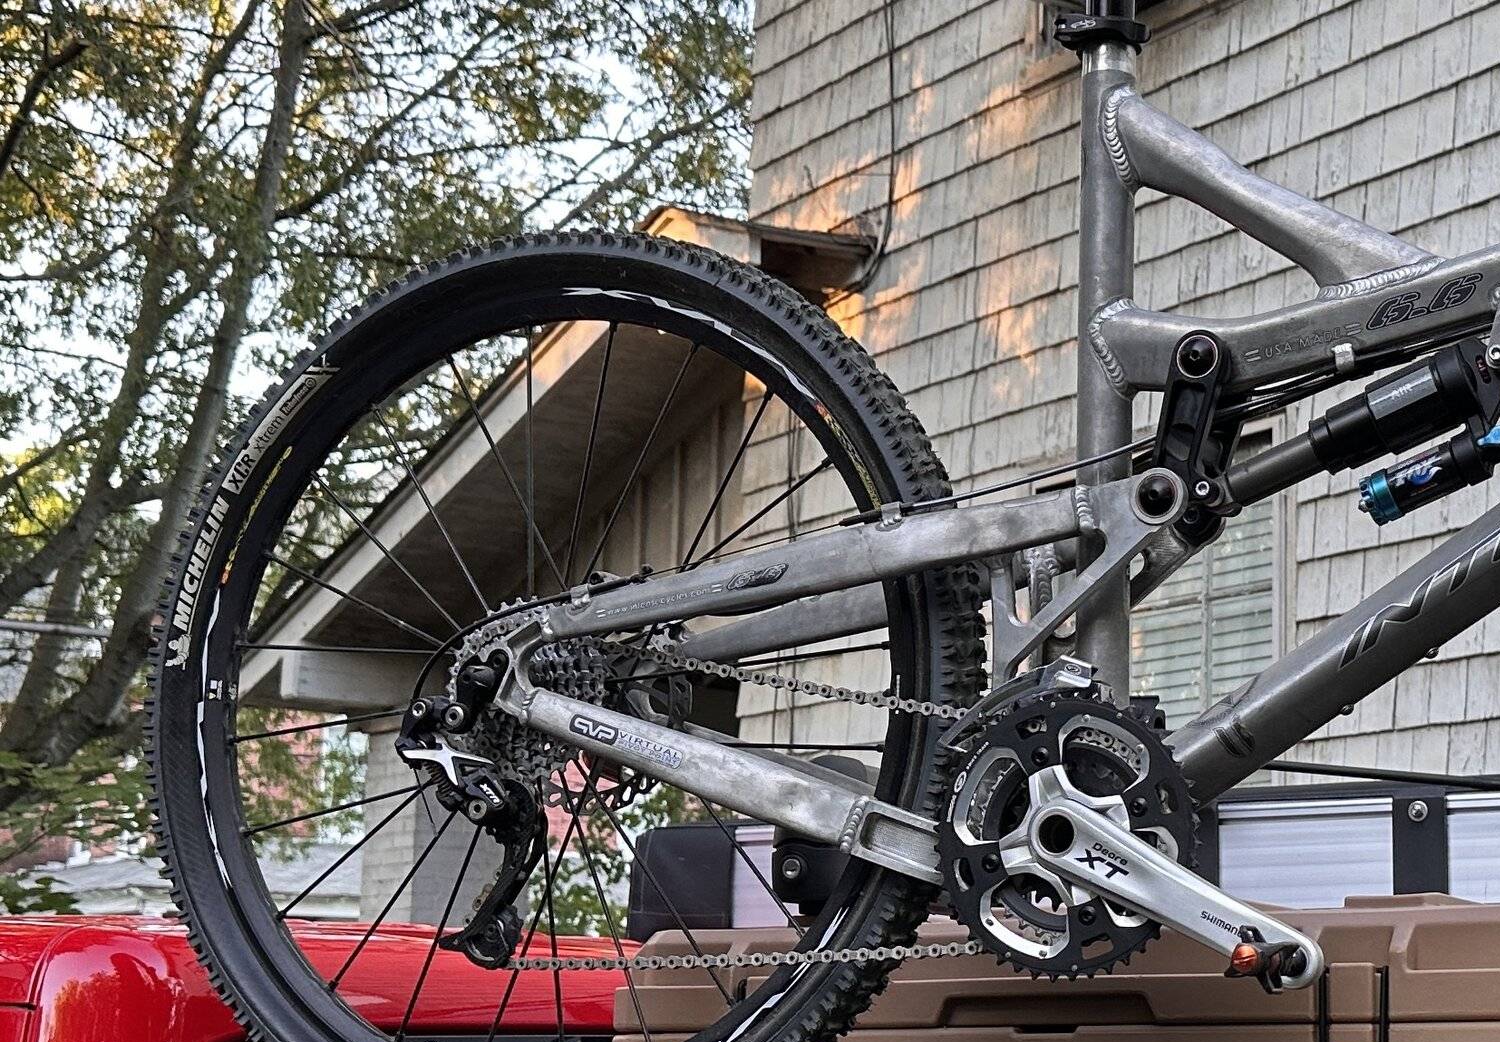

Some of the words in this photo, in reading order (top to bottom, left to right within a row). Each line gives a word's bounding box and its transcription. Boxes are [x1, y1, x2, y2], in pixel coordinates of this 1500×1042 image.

[1265, 342, 1293, 359] USA
[1300, 326, 1341, 349] MADE
[228, 453, 256, 489] XCR
[173, 494, 230, 632] MICHELIN
[1075, 849, 1129, 879] XT
[1092, 842, 1128, 866] Deore
